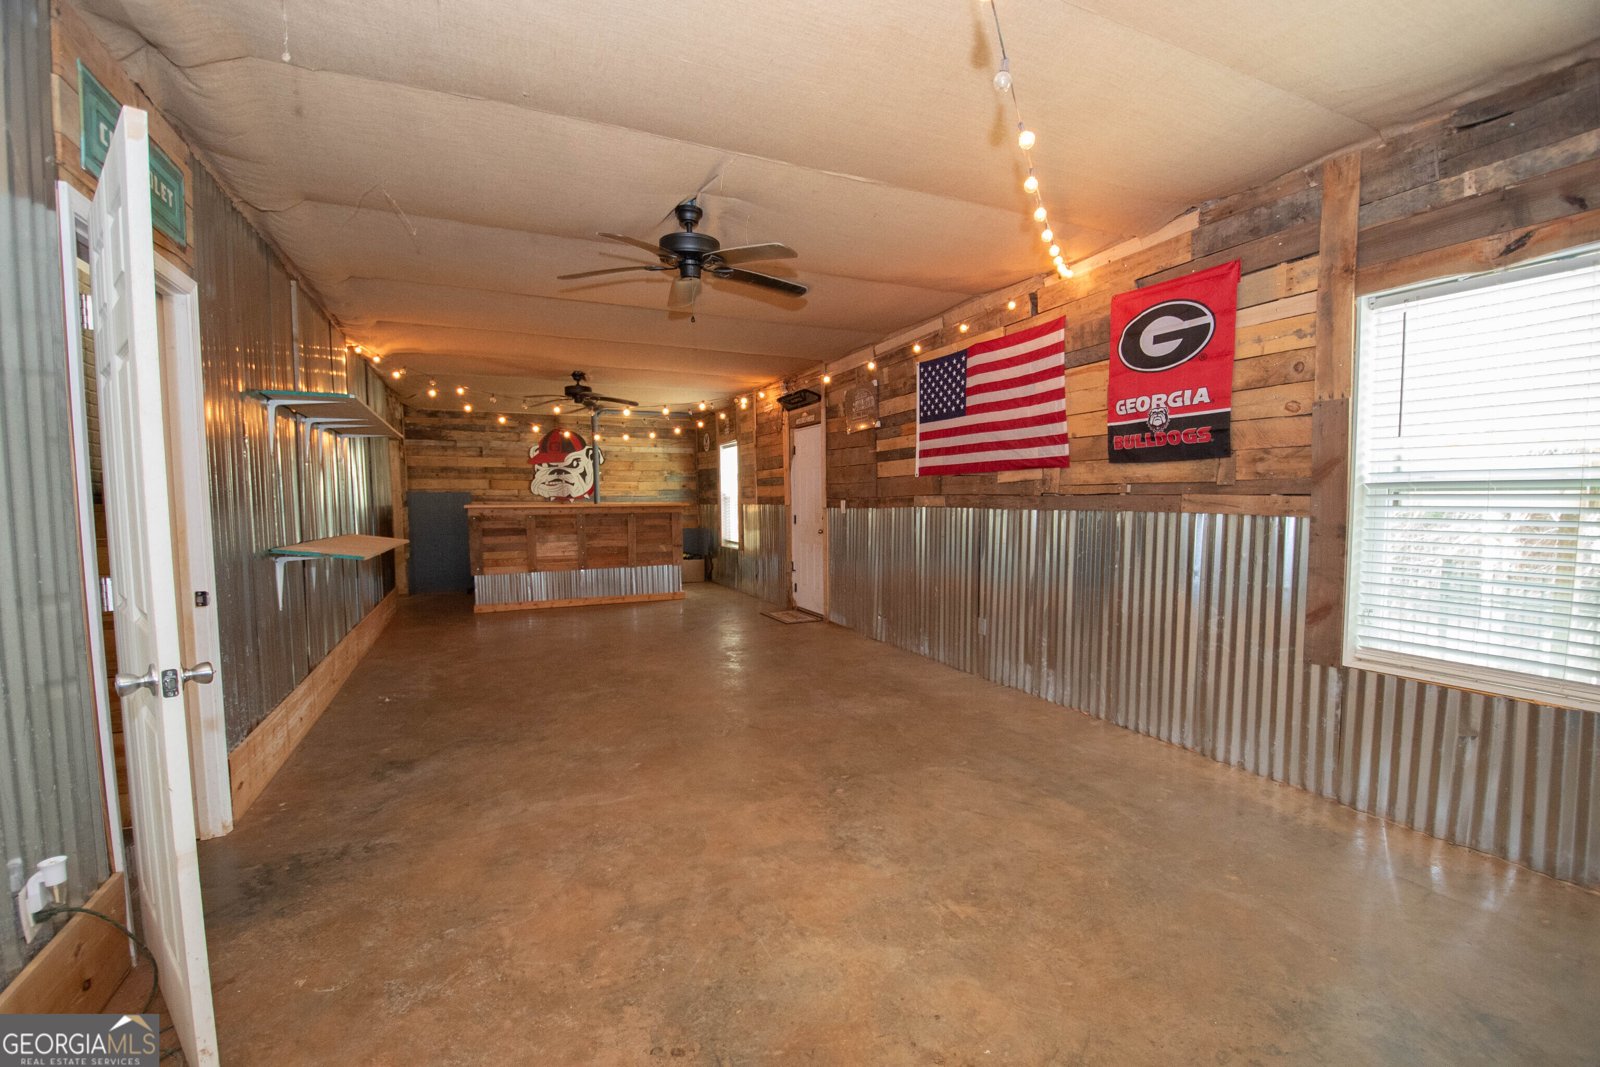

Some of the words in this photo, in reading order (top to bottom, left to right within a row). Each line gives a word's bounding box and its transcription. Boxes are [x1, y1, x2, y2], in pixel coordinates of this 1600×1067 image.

[1119, 301, 1214, 372] G
[1115, 387, 1211, 415] GEORGIA
[1113, 426, 1213, 451] BULLDOGS
